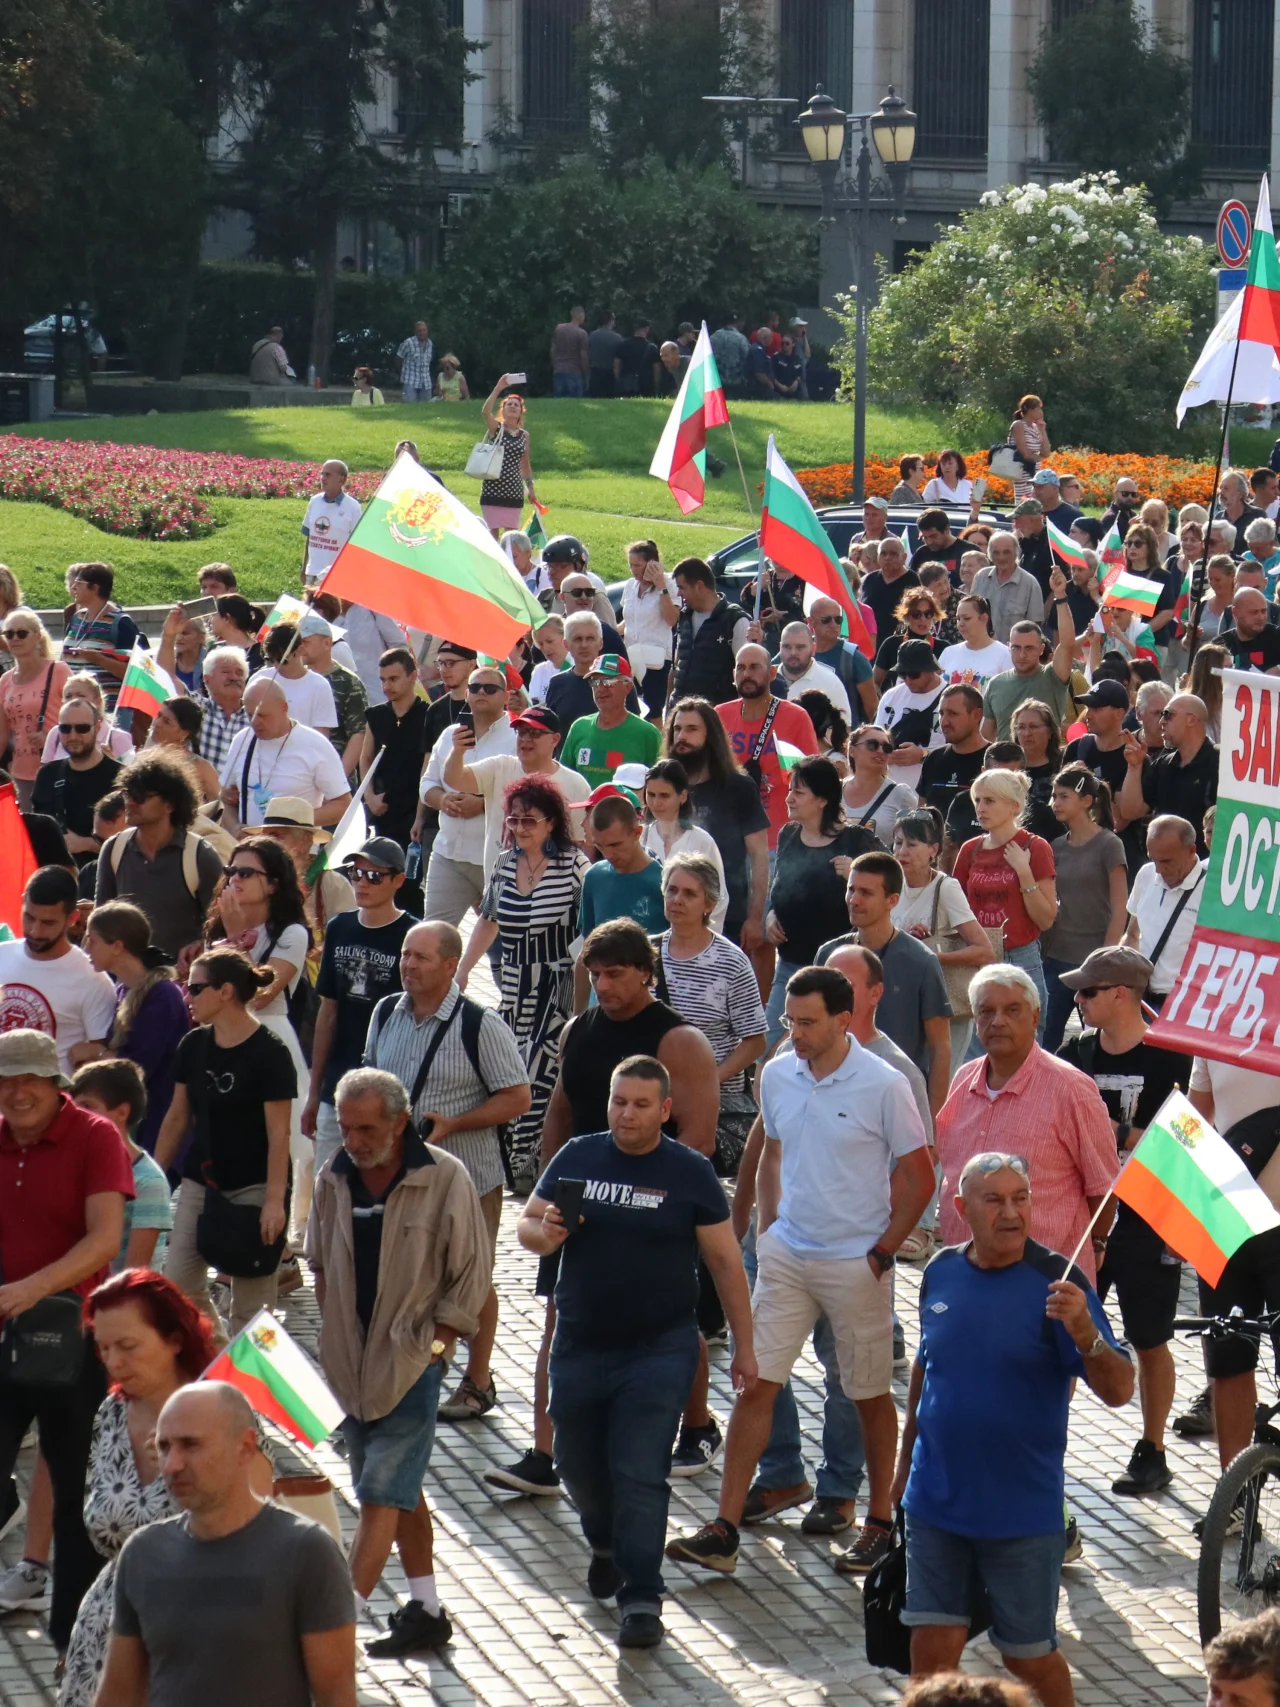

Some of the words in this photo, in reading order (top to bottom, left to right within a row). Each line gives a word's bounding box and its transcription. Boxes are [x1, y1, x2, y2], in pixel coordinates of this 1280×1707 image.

[759, 718, 772, 744] SPACE
[971, 870, 1014, 884] Mistakes
[979, 908, 1007, 925] ROBOT
[334, 946, 367, 958] SAILING
[369, 951, 396, 969] TODAY
[1166, 941, 1279, 1057] ГЕРБ,
[582, 1179, 632, 1205] MOVE
